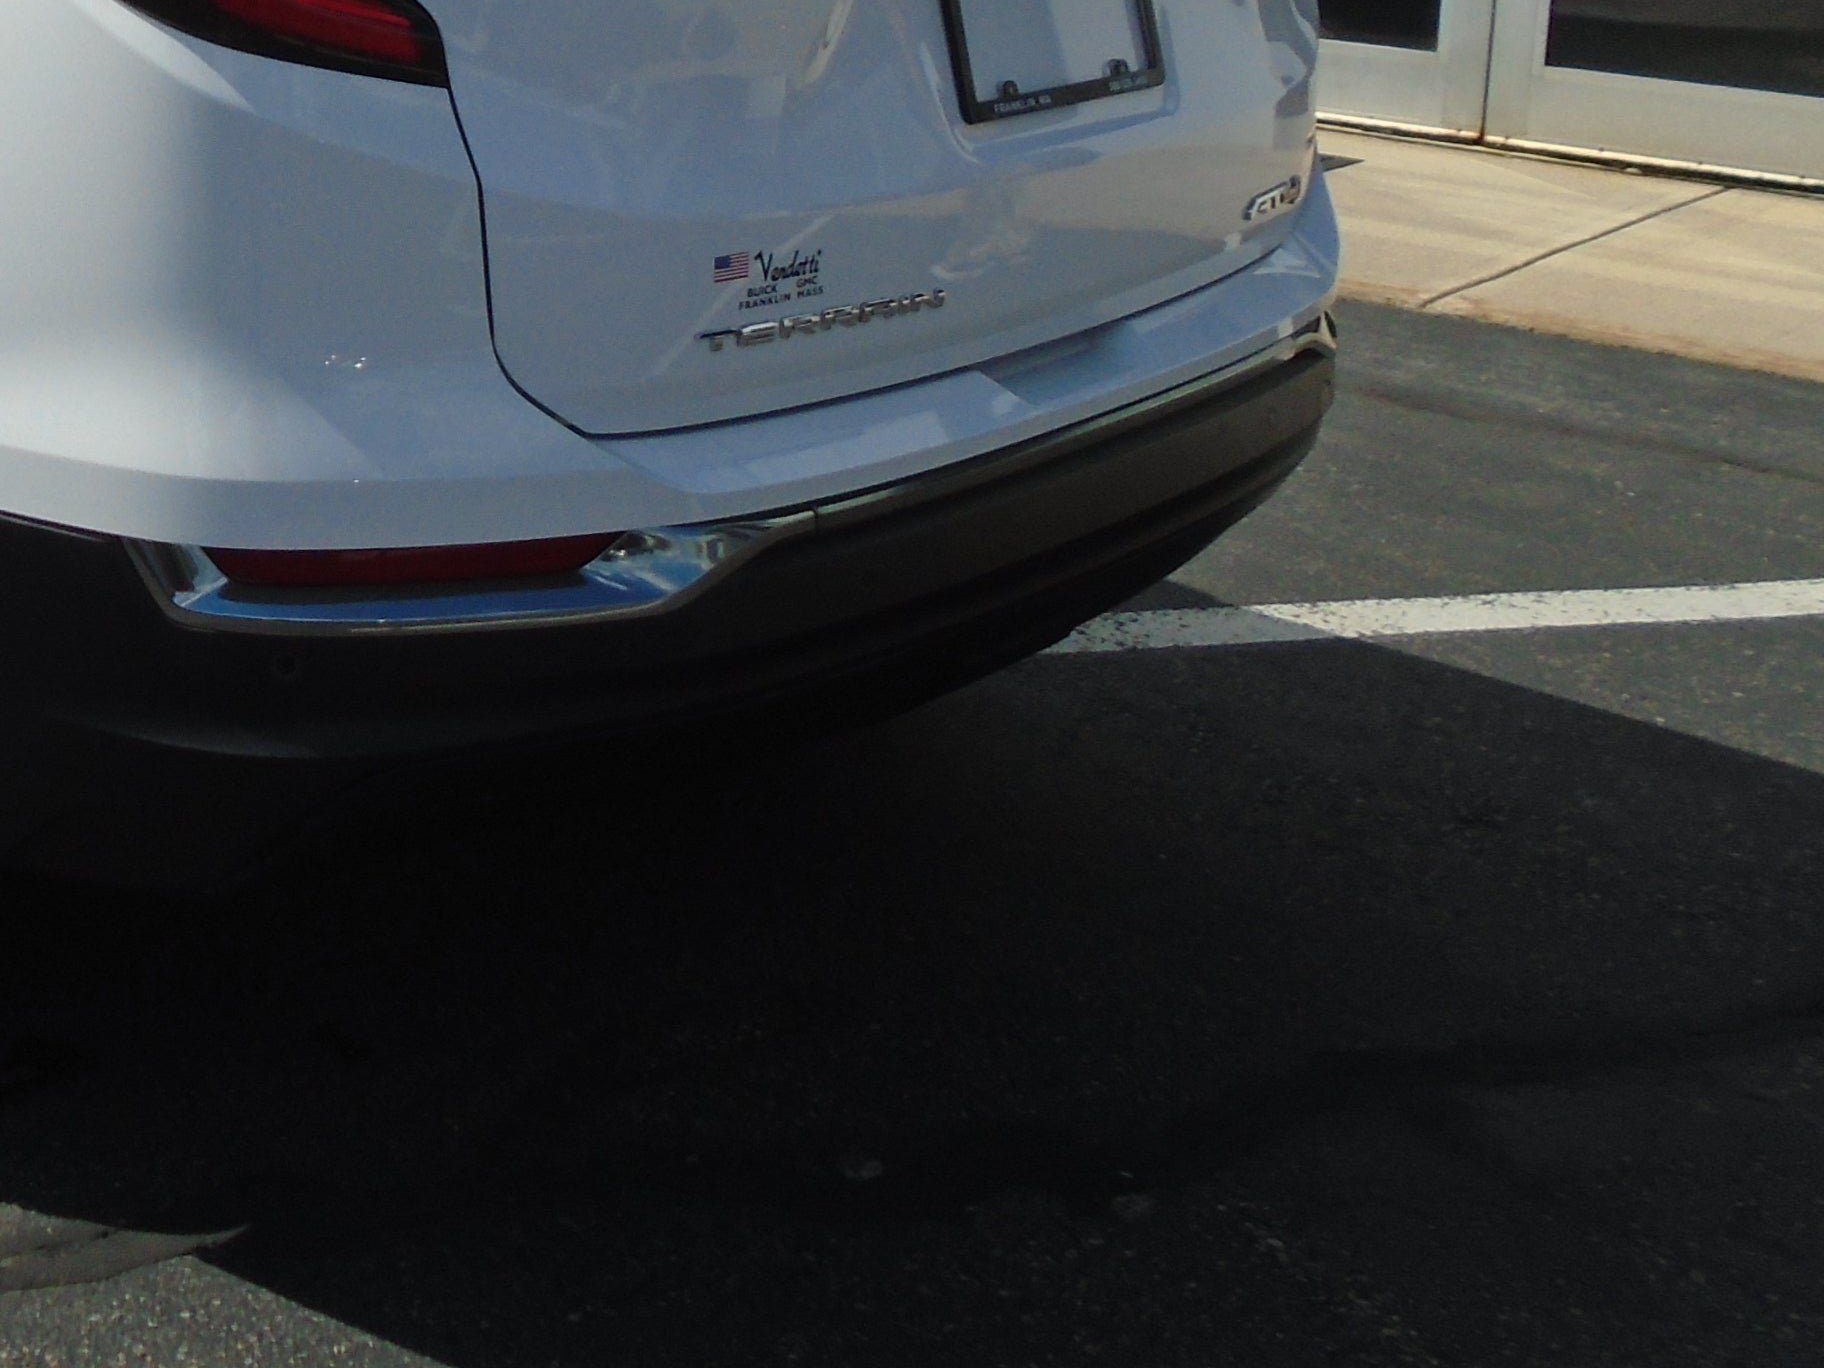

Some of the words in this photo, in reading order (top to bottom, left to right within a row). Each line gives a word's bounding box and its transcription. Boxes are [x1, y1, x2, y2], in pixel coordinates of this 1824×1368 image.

[738, 292, 792, 311] FRANKLIN
[797, 285, 824, 300] MASS
[747, 284, 778, 299] BUICK
[694, 287, 946, 352] TERRAIN
